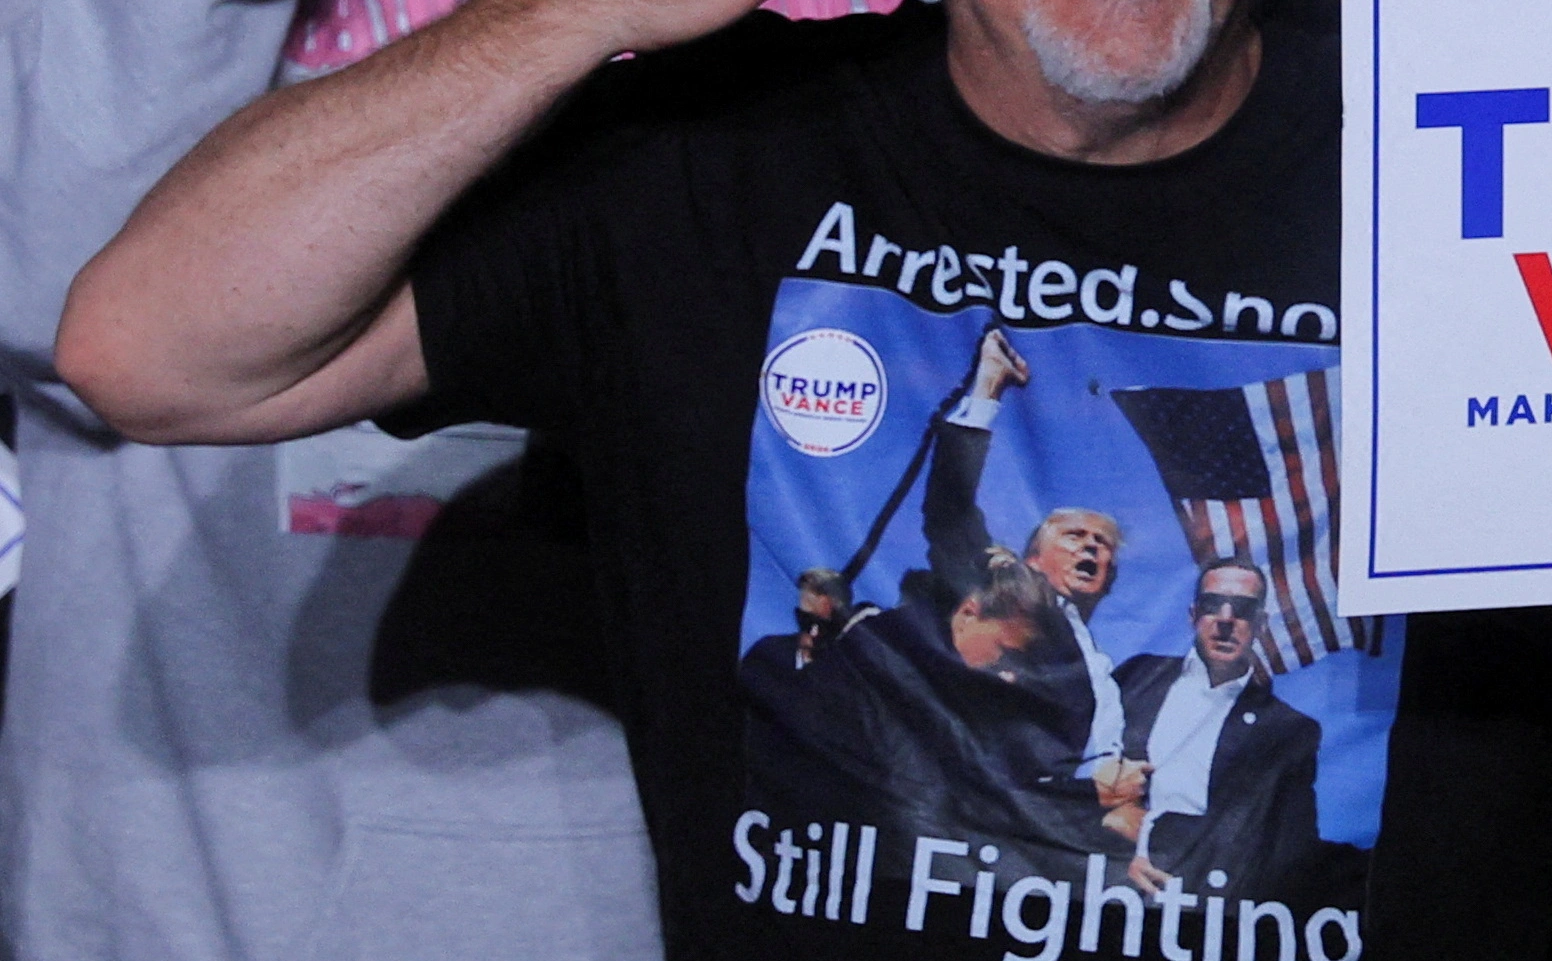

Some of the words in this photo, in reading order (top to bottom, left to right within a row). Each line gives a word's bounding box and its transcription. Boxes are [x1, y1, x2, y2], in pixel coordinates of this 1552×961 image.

[772, 372, 877, 400] TRUMP
[781, 392, 864, 416] VANCE
[733, 809, 878, 924] Still
[905, 836, 1364, 961] Fighting
